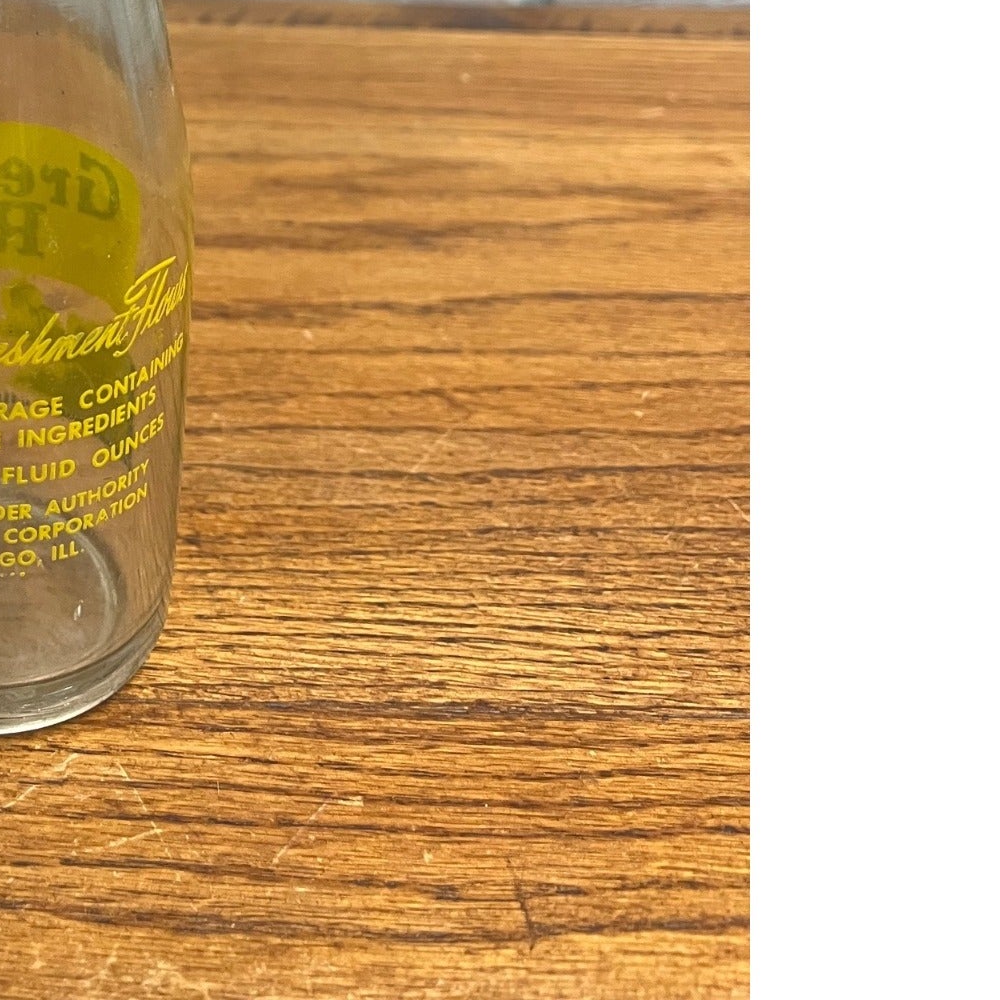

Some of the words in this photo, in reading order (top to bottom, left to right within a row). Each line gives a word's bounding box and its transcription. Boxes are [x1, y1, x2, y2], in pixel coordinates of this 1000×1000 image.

[79, 332, 184, 409] CONTAINING
[18, 385, 157, 448] INGREDIENTS
[2, 459, 77, 486] FLUID
[91, 412, 165, 469] OUNCES
[3, 482, 149, 545] CORPORATION
[44, 458, 151, 518] AUTHORITY
[51, 541, 85, 562] ILL.
